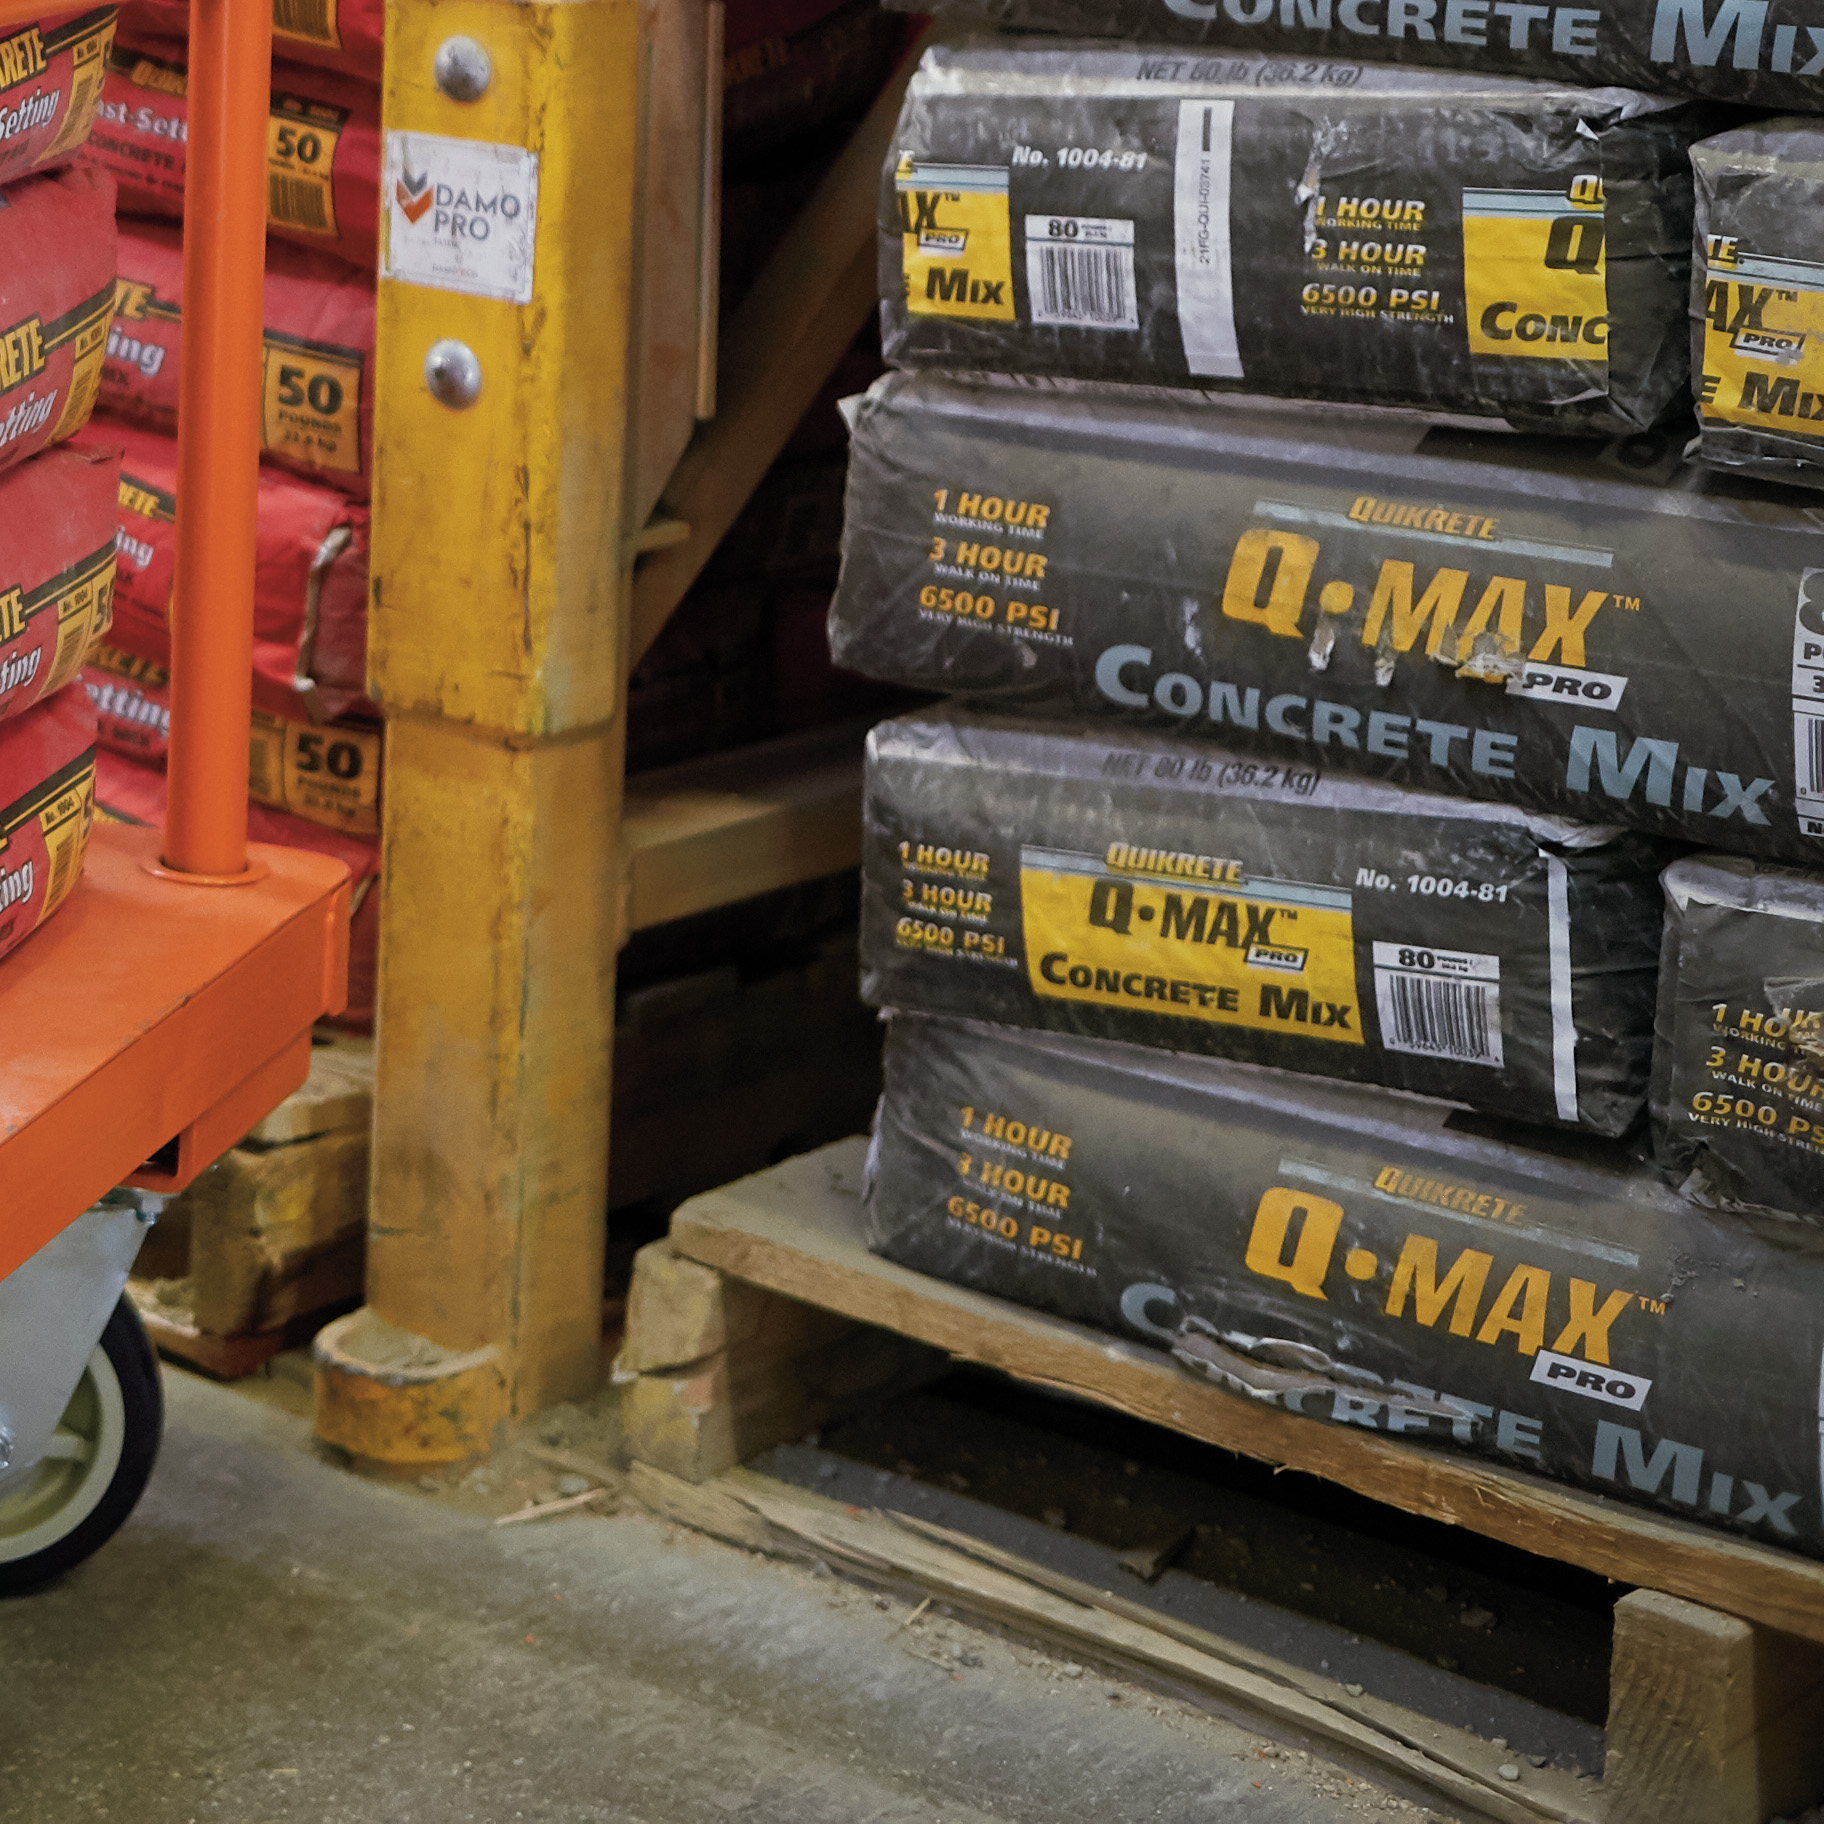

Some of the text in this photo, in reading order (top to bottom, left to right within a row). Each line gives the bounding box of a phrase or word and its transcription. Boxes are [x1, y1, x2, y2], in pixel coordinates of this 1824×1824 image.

[276, 127, 322, 165] 50
[1012, 146, 1148, 170] No. 1004-81
[435, 184, 522, 219] DAMO
[1338, 198, 1426, 222] HOUR
[434, 210, 492, 242] PRO
[1311, 240, 1427, 266] 3 HOUR
[1302, 283, 1441, 312] 6500 PSI
[278, 364, 344, 416] 50
[933, 489, 1051, 529] 1 HOUR
[1348, 495, 1502, 540] QUIKRETE
[929, 538, 1049, 579] 3 HOUR
[919, 584, 1061, 631] 6500 PSI
[1524, 673, 1613, 701] PRO
[1095, 644, 1776, 826] CONCRETE MIX
[1106, 842, 1245, 883] QUIKRETE
[1355, 867, 1509, 904] No. 1004-81
[1254, 949, 1300, 965] PRO
[1397, 948, 1435, 970] 80
[1038, 952, 1353, 1031] CONCRETE MIX
[1374, 1165, 1529, 1224] QUIKRETE
[1546, 1362, 1637, 1399] PRO
[1592, 1419, 1804, 1536] MIX
